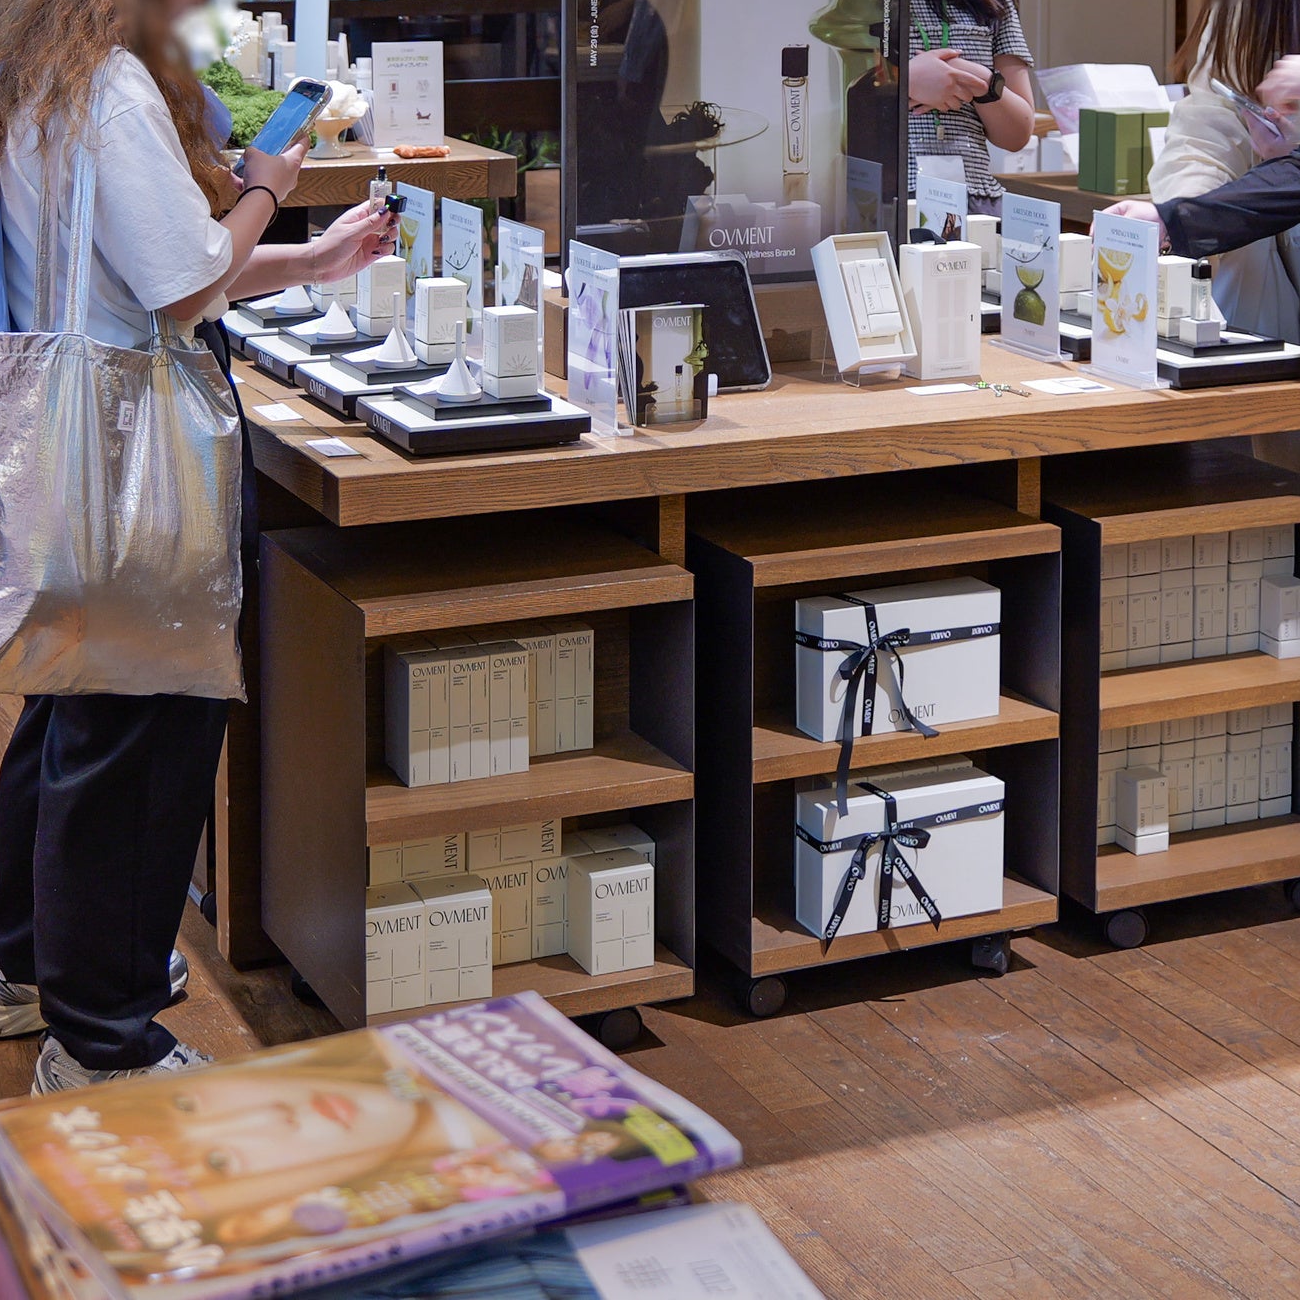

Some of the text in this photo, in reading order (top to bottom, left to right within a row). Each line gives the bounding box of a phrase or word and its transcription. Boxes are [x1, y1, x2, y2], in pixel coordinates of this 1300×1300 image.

[590, 0, 598, 19] JUNE
[791, 89, 801, 132] OVMENT
[709, 226, 775, 248] OVMENT
[744, 247, 796, 259] Wellness Brand
[936, 260, 969, 273] OVMENT
[653, 315, 691, 328] OVMENT
[310, 378, 327, 399] OVMENT
[372, 413, 391, 435] OVMENT
[559, 635, 591, 648] OVMENT
[412, 665, 447, 678] OVMENT
[453, 661, 487, 674] OVMENT
[493, 655, 527, 669] OVMENT
[864, 699, 873, 724] OVMENT
[935, 812, 958, 824] OVMENT
[978, 802, 1001, 814] OVMENT
[541, 820, 555, 854] MENT
[444, 834, 458, 869] MENT
[482, 871, 529, 891] VMENT
[536, 865, 569, 883] OVM
[595, 876, 650, 900] OVMENT
[429, 906, 488, 928] OVMENT
[880, 899, 889, 923] OVMENT
[366, 914, 422, 938] OVMENT
